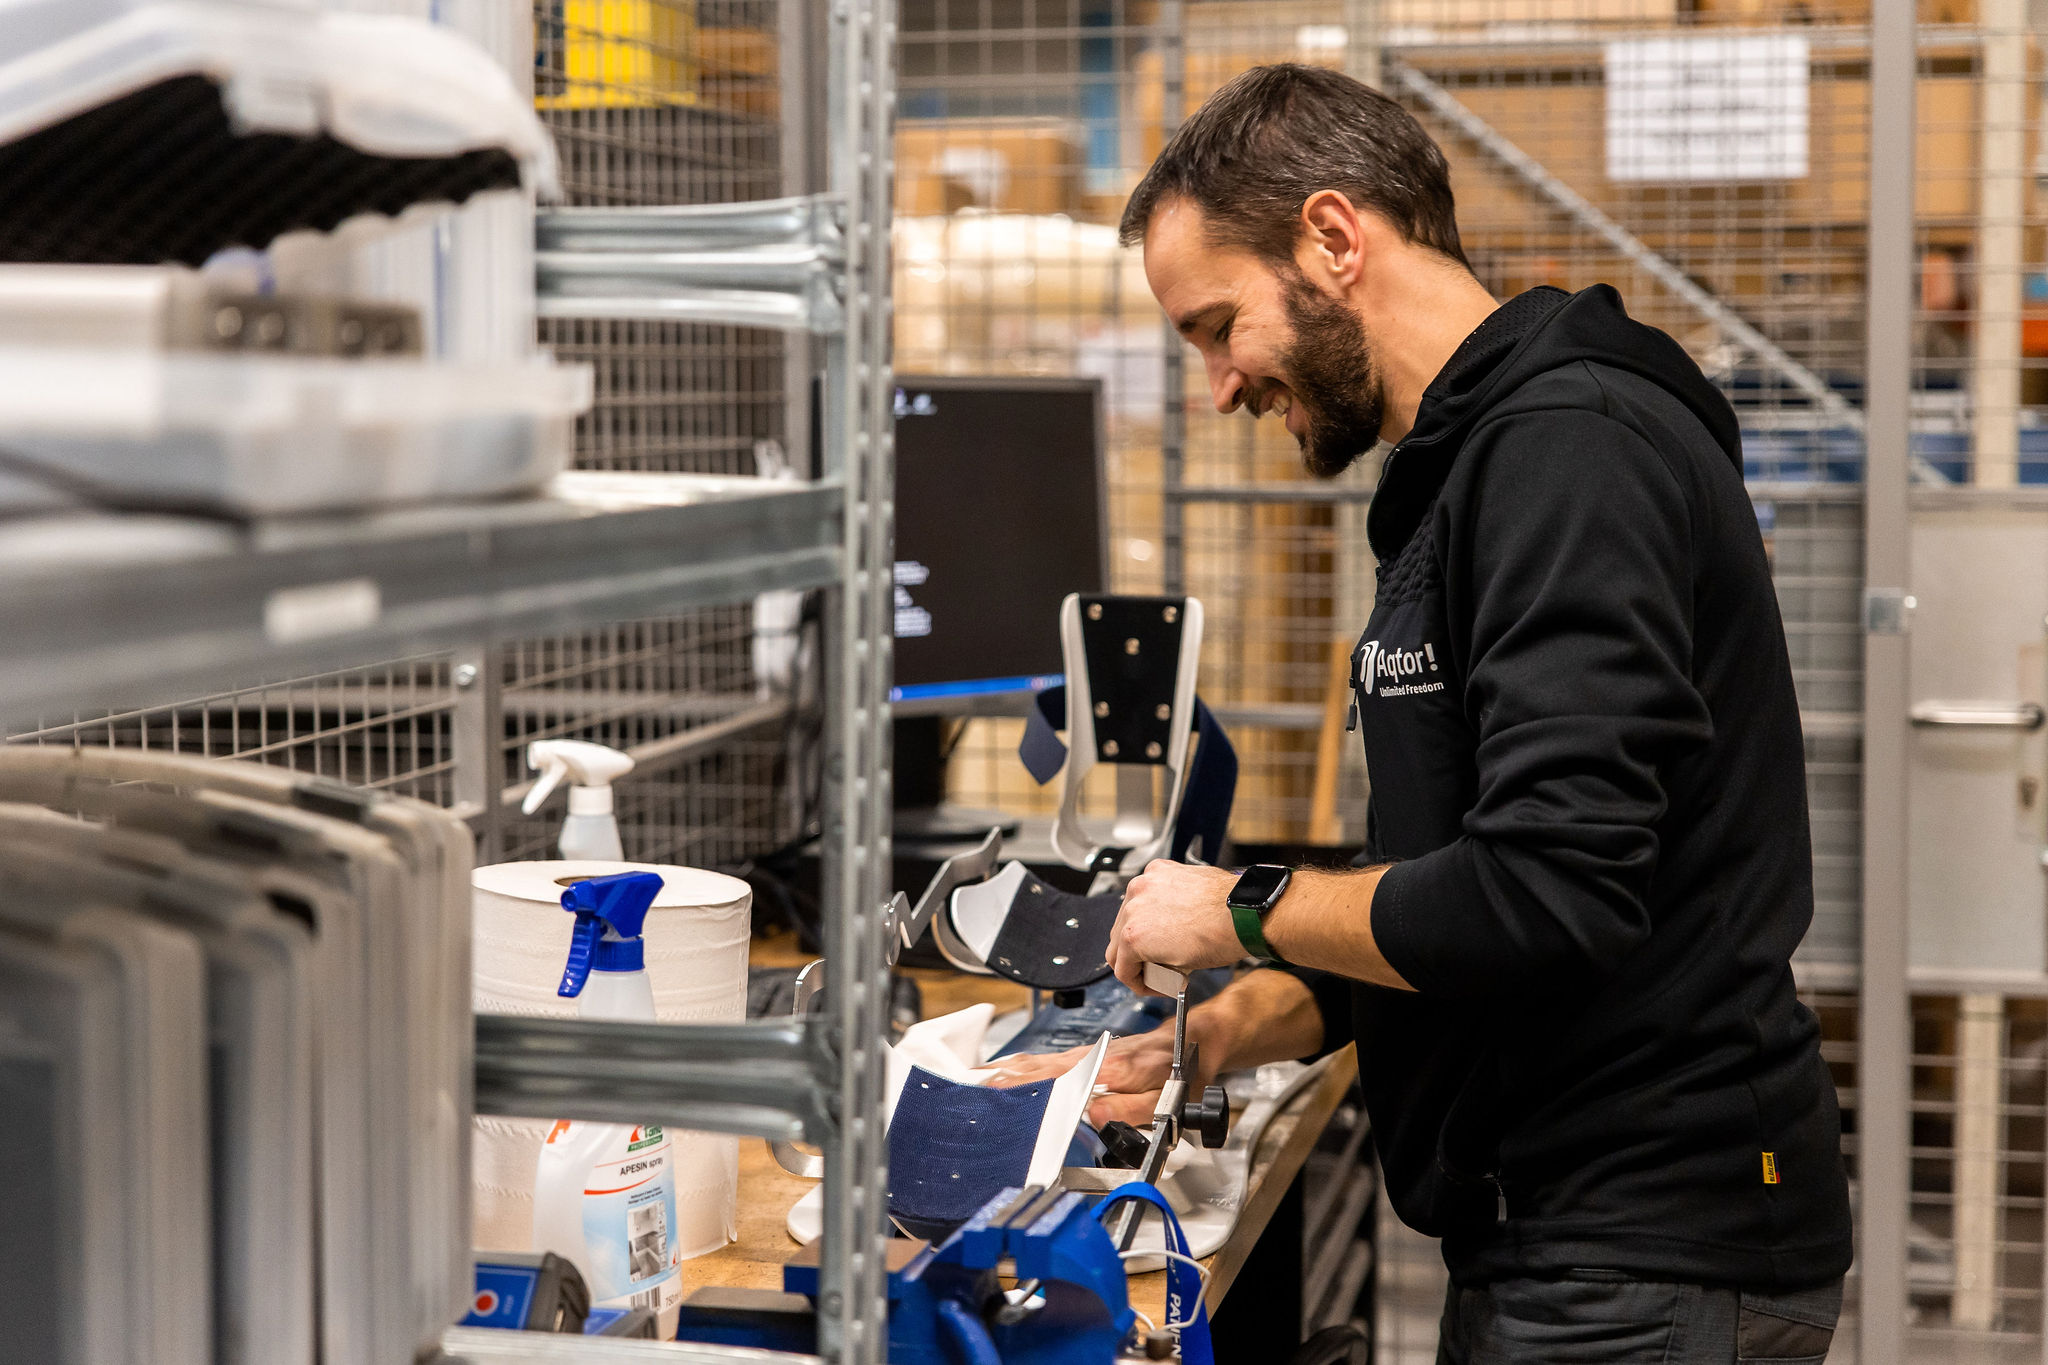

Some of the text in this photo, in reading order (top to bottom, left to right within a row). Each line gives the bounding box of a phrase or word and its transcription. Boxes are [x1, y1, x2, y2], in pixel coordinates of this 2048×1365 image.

[1377, 643, 1438, 683] Aqtor!
[1379, 682, 1444, 697] Unlimited Freedom
[620, 1157, 663, 1176] APESIN spray
